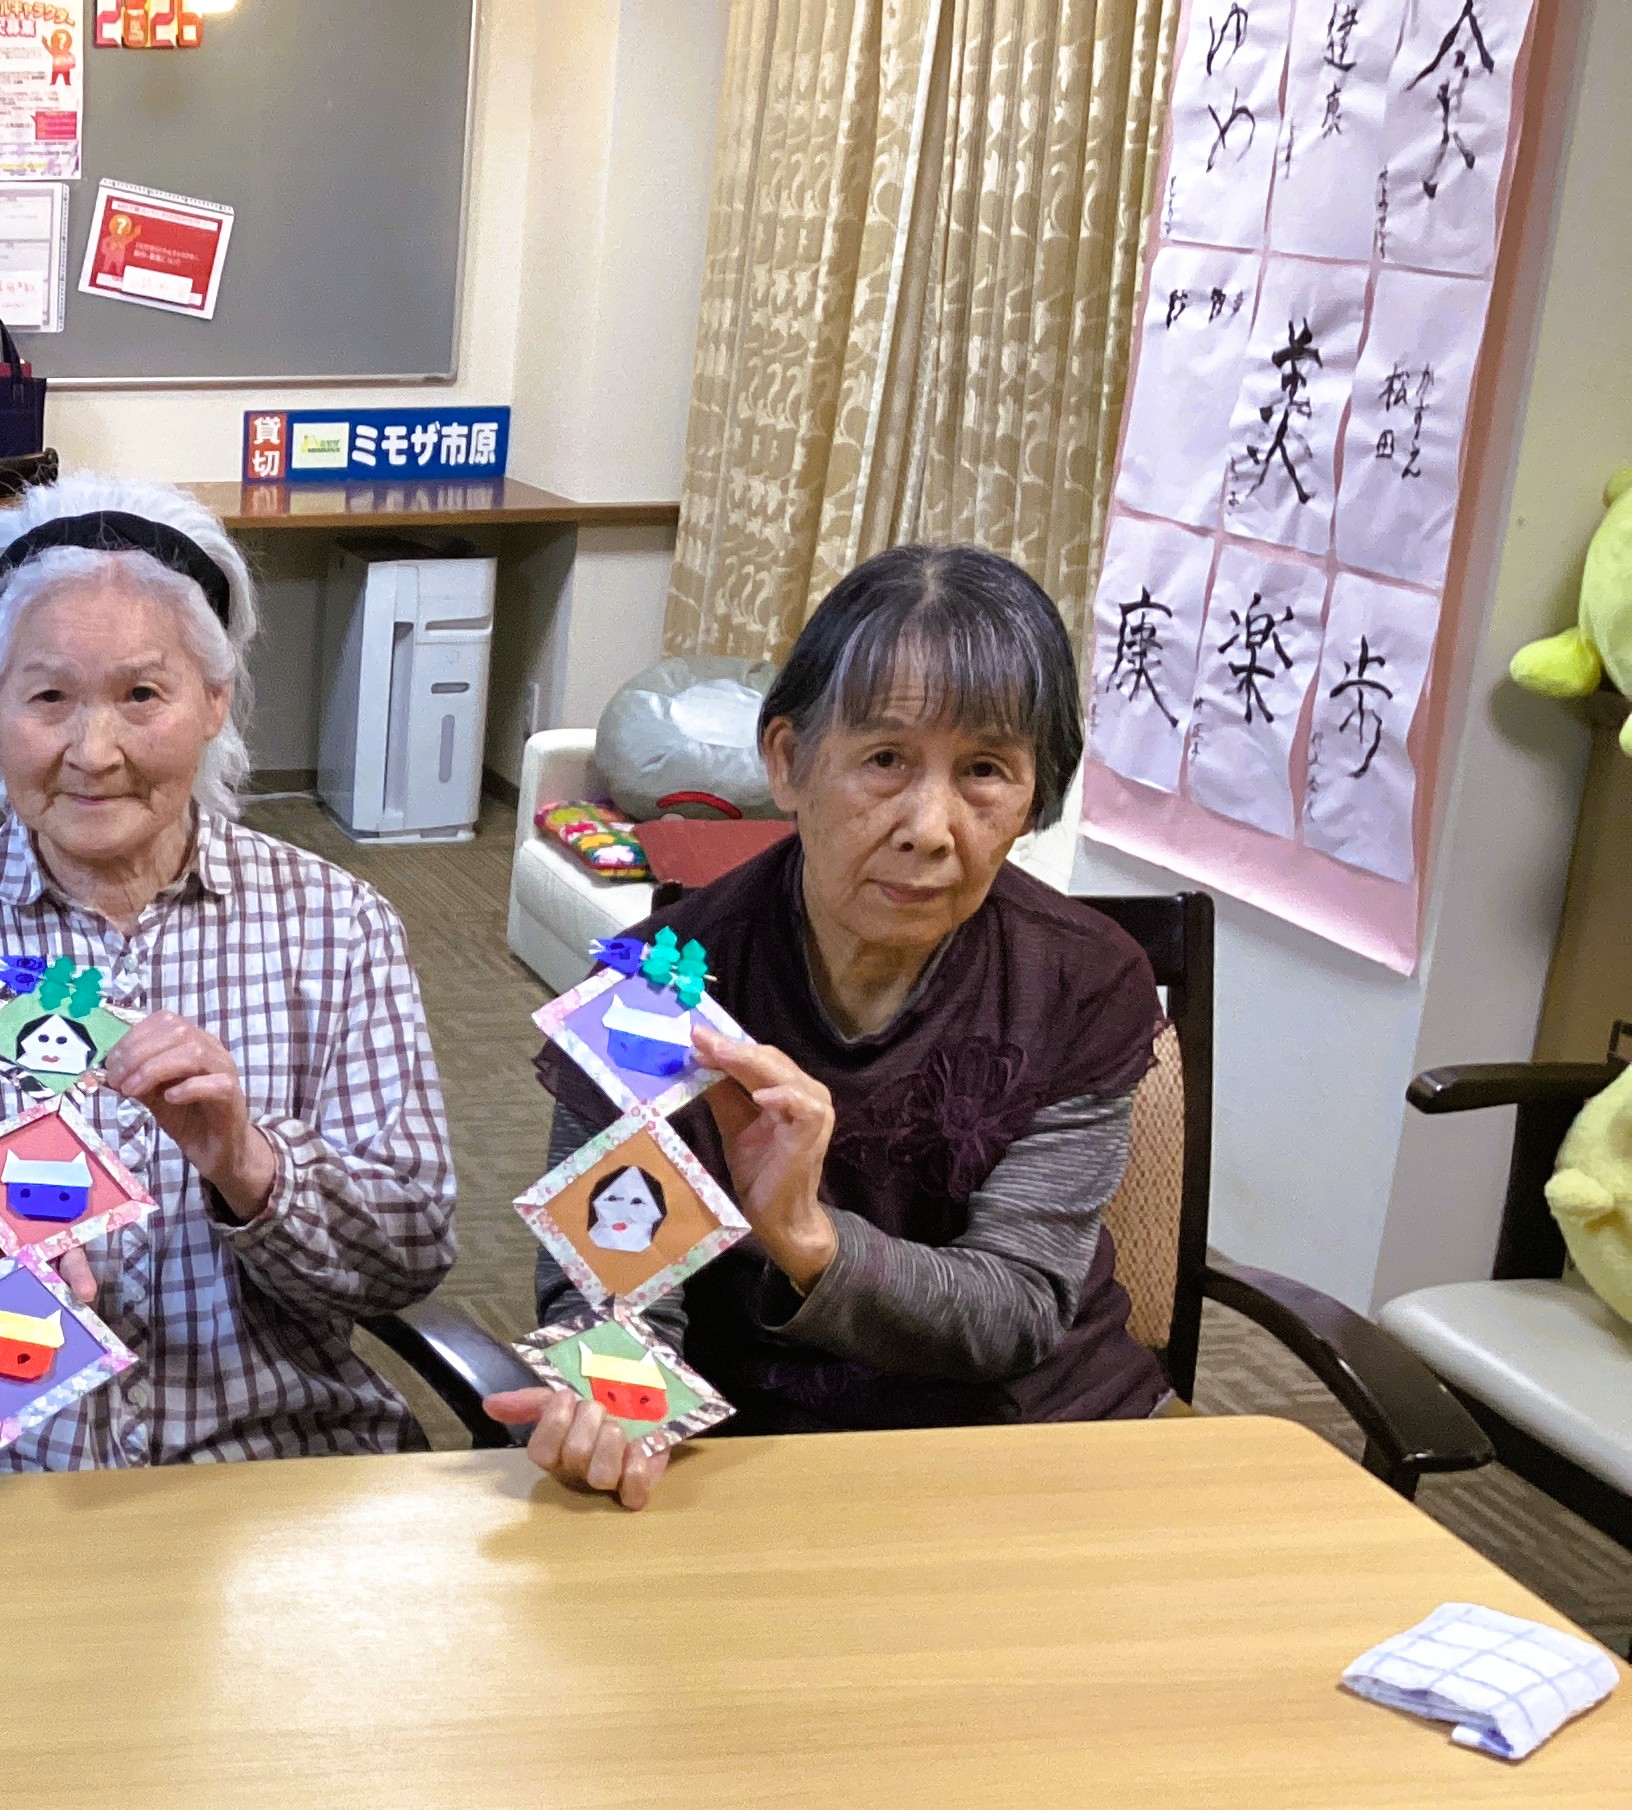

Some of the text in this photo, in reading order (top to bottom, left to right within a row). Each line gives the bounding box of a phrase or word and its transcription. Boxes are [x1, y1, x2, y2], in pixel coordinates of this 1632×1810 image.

[252, 416, 282, 477] 貸切
[351, 420, 499, 467] ミモザ市原
[1377, 361, 1410, 459] 松田
[1217, 592, 1294, 724] 楽
[1329, 634, 1394, 780] 歩
